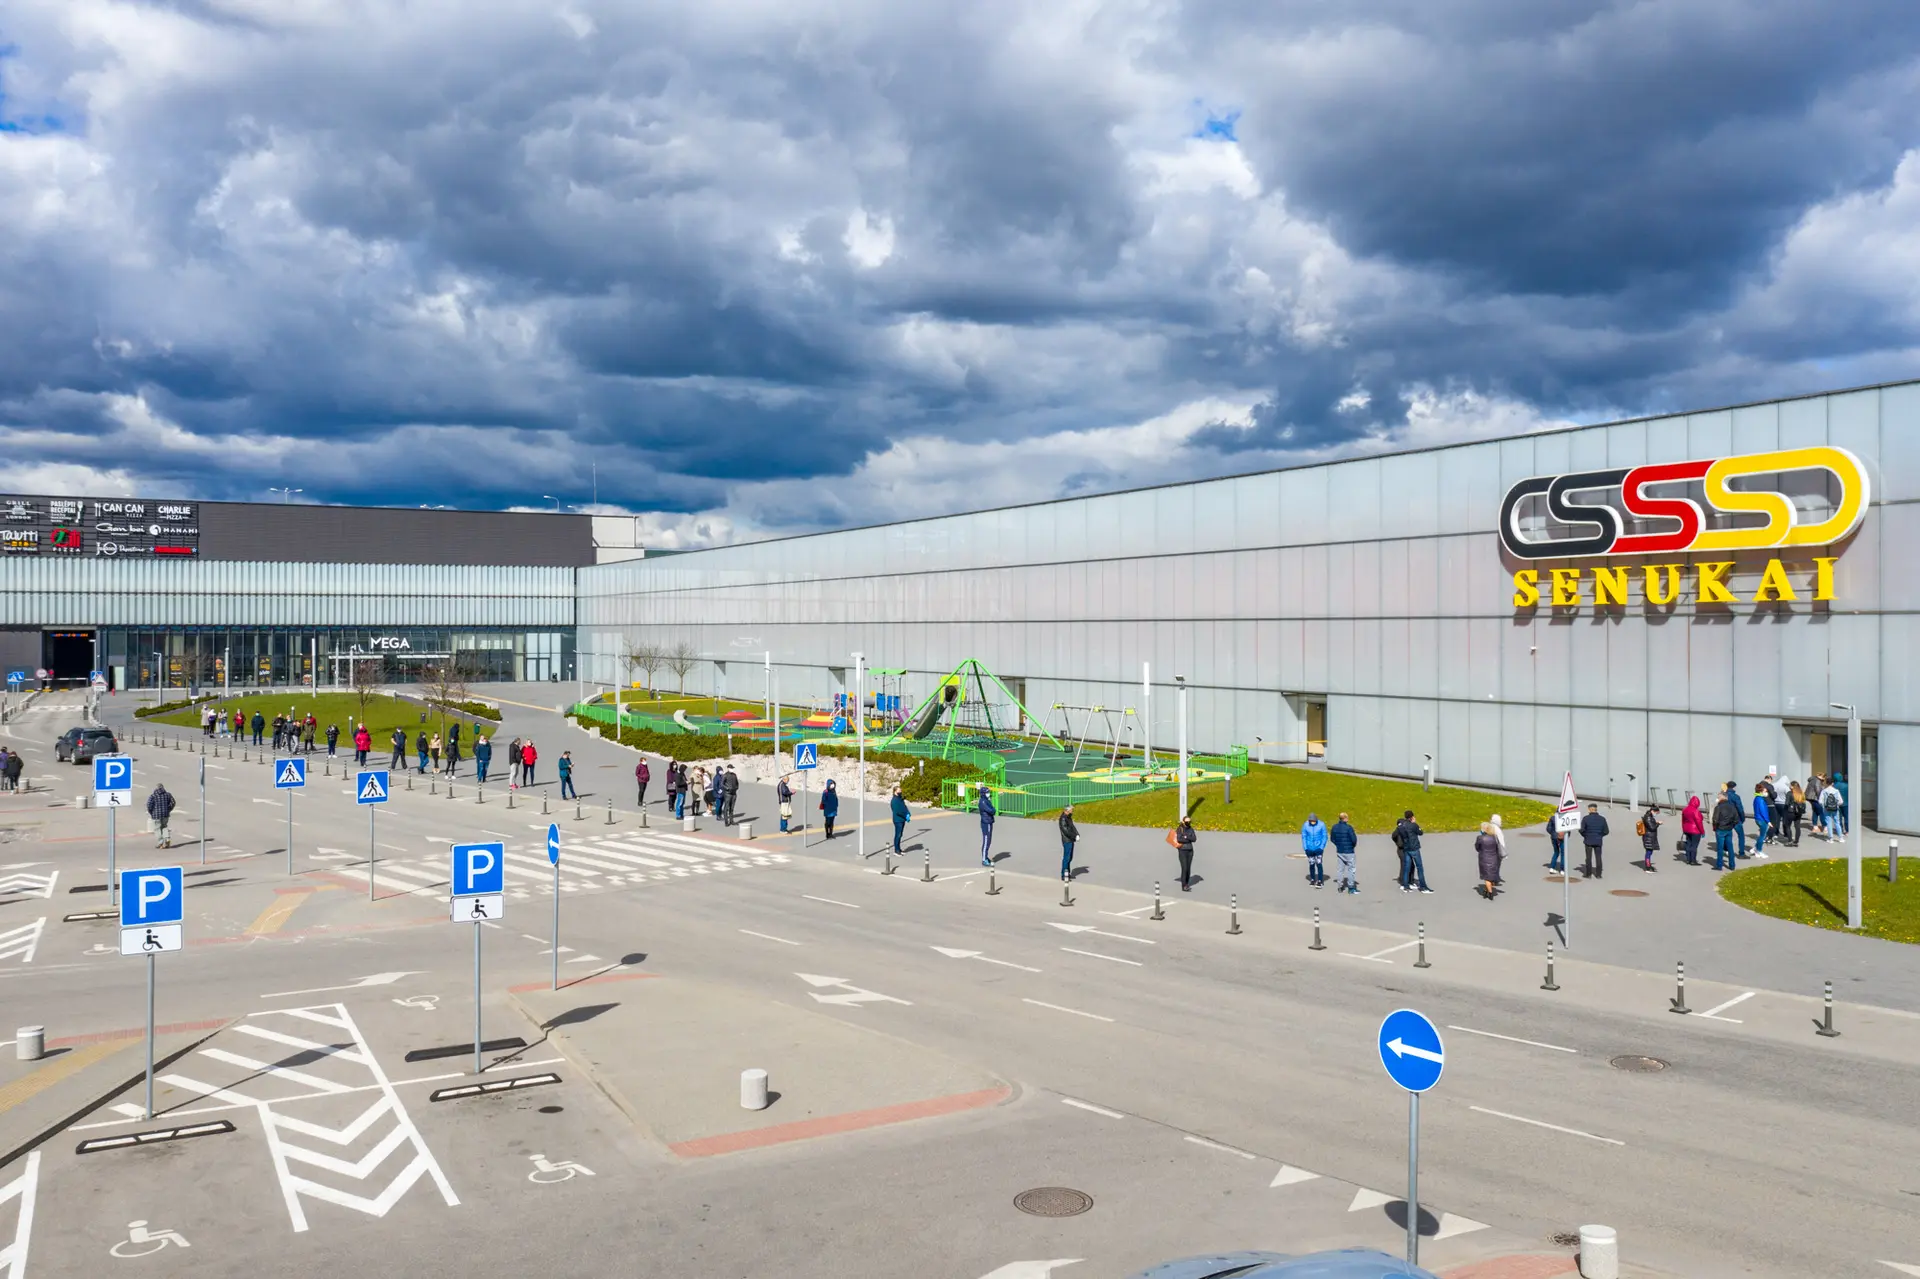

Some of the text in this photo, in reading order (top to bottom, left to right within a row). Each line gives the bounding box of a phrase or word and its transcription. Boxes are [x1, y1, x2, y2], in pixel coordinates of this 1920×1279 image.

[103, 503, 144, 513] CAN CAN
[158, 506, 191, 514] CHARLIE
[1513, 557, 1839, 607] SENUKAI
[370, 637, 411, 649] MEGA
[105, 761, 126, 787] P
[1561, 817, 1570, 827] 20
[467, 849, 495, 889] P
[138, 875, 172, 919] P
